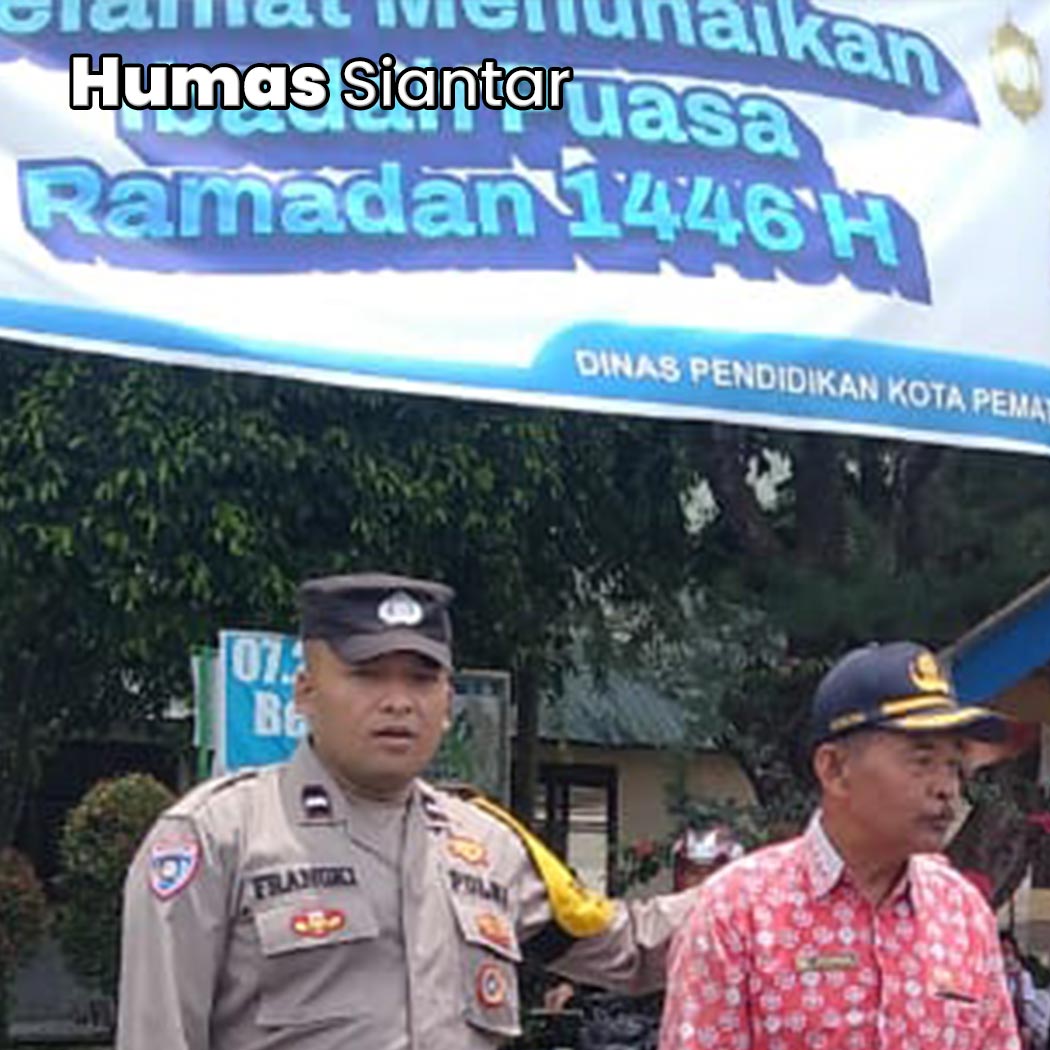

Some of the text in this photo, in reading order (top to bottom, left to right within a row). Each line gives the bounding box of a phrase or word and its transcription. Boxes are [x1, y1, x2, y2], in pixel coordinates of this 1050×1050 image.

[23, 160, 899, 267] Ramadan 1446 H
[575, 348, 681, 384] DINAS
[690, 357, 879, 401] PENDIDIKAN
[888, 377, 967, 412] KOTA
